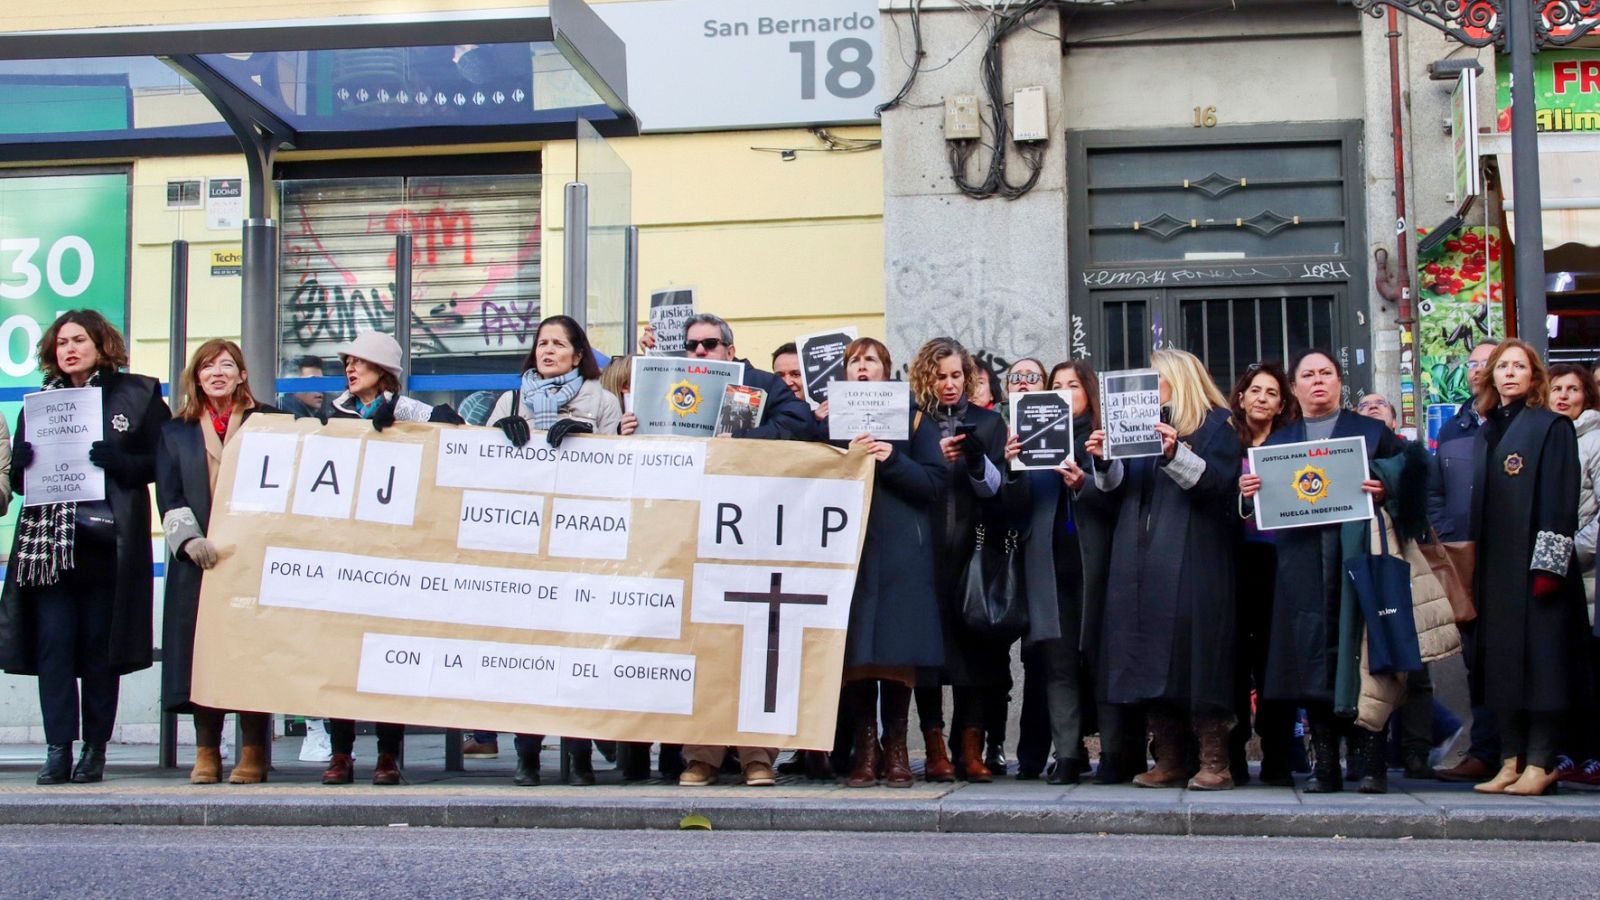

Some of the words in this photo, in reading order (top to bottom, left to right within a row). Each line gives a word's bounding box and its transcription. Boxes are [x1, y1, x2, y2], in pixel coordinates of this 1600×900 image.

[703, 19, 749, 38] San
[757, 11, 876, 35] Bernardo
[789, 37, 876, 100] 18
[1193, 105, 1217, 128] 16
[211, 187, 239, 197] LOOMIS
[0, 234, 94, 299] 30
[46, 402, 77, 413] PACTA
[1121, 392, 1159, 409] justicia
[48, 414, 74, 425] SUNT
[37, 424, 89, 438] SERVANDA
[1122, 434, 1142, 443] hace
[1143, 432, 1161, 441] nada
[446, 442, 468, 455] SIN
[479, 444, 557, 462] LETRADOS
[560, 452, 614, 465] ADMON
[618, 453, 633, 465] DE
[641, 454, 694, 467] JUSTICIA
[1262, 454, 1290, 462] JUSTICIA
[1308, 448, 1354, 457] LAJUSTICIA
[55, 463, 69, 472] LO
[42, 473, 86, 483] PACTADO
[46, 484, 82, 493] OBLIGA
[1280, 509, 1309, 518] HUELGA
[1311, 504, 1353, 514] INDEFINIDA
[462, 506, 540, 527] JUSTICIA
[555, 514, 627, 532] PARADA
[270, 561, 301, 576] POR
[306, 564, 324, 578] LA
[337, 566, 411, 587] INACCIÓN
[420, 576, 449, 592] DEL
[454, 578, 532, 595] MINISTERIO
[537, 585, 559, 600] DE
[575, 589, 596, 603] IN-
[609, 591, 676, 608] JUSTICIA
[384, 649, 421, 666] CON
[444, 654, 464, 668] LA
[481, 655, 555, 671] BENDICIÓN
[572, 663, 599, 678] DEL
[613, 664, 692, 682] GOBIERNO
